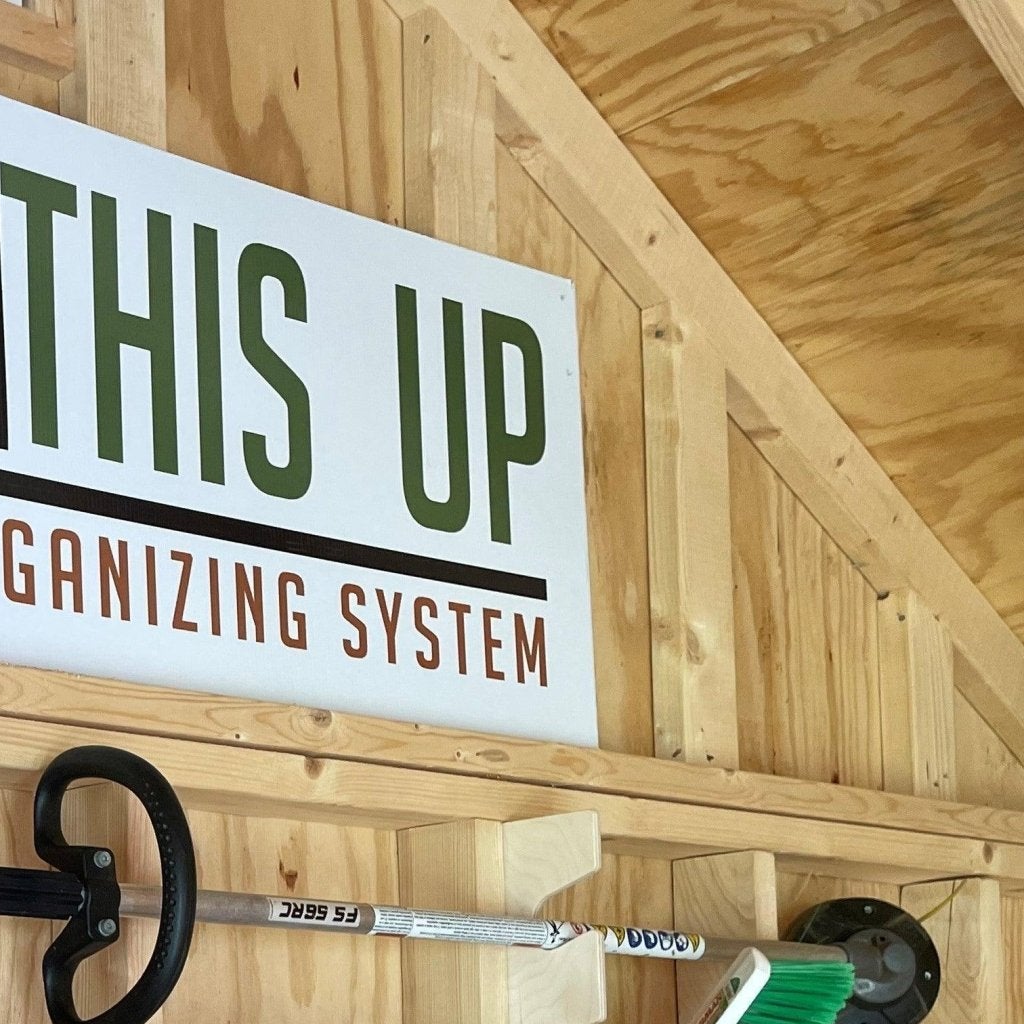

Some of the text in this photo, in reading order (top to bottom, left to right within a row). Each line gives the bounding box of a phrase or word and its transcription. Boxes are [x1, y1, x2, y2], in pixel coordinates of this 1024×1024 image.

[395, 284, 547, 545] UP
[341, 583, 549, 687] SYSTEM
[279, 902, 358, 923] FS 56RC
